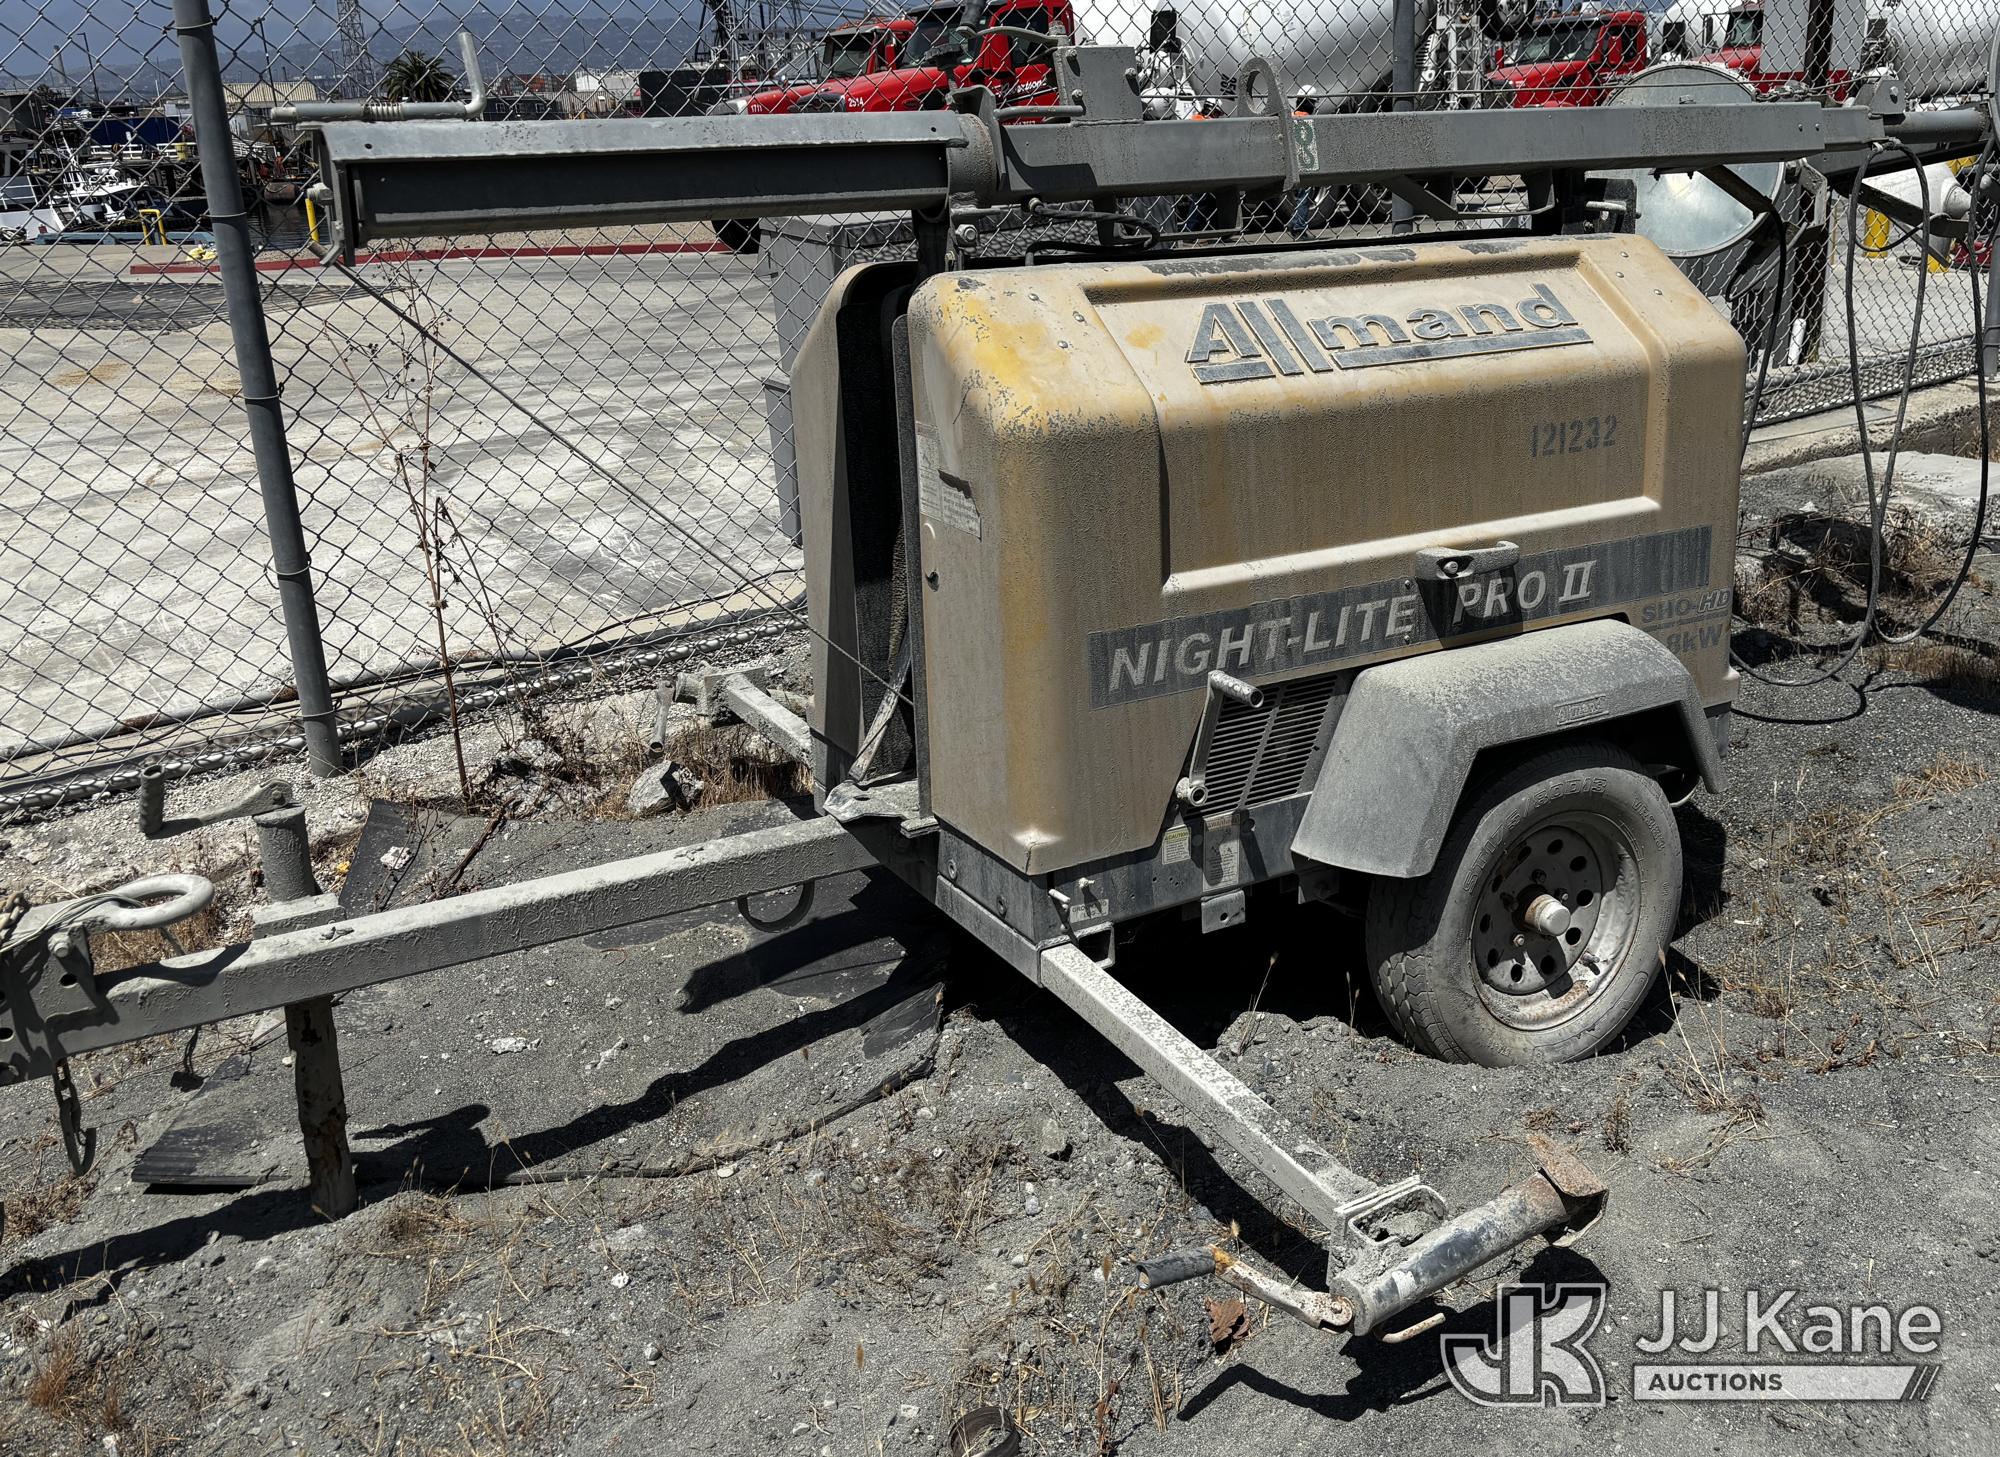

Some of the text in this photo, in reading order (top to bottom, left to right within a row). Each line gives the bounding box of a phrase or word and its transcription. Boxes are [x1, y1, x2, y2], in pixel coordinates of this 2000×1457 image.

[1185, 282, 1580, 376] Allmand
[1531, 414, 1617, 457] 121232
[1108, 560, 1597, 693] NIGHT-LITE PRO II
